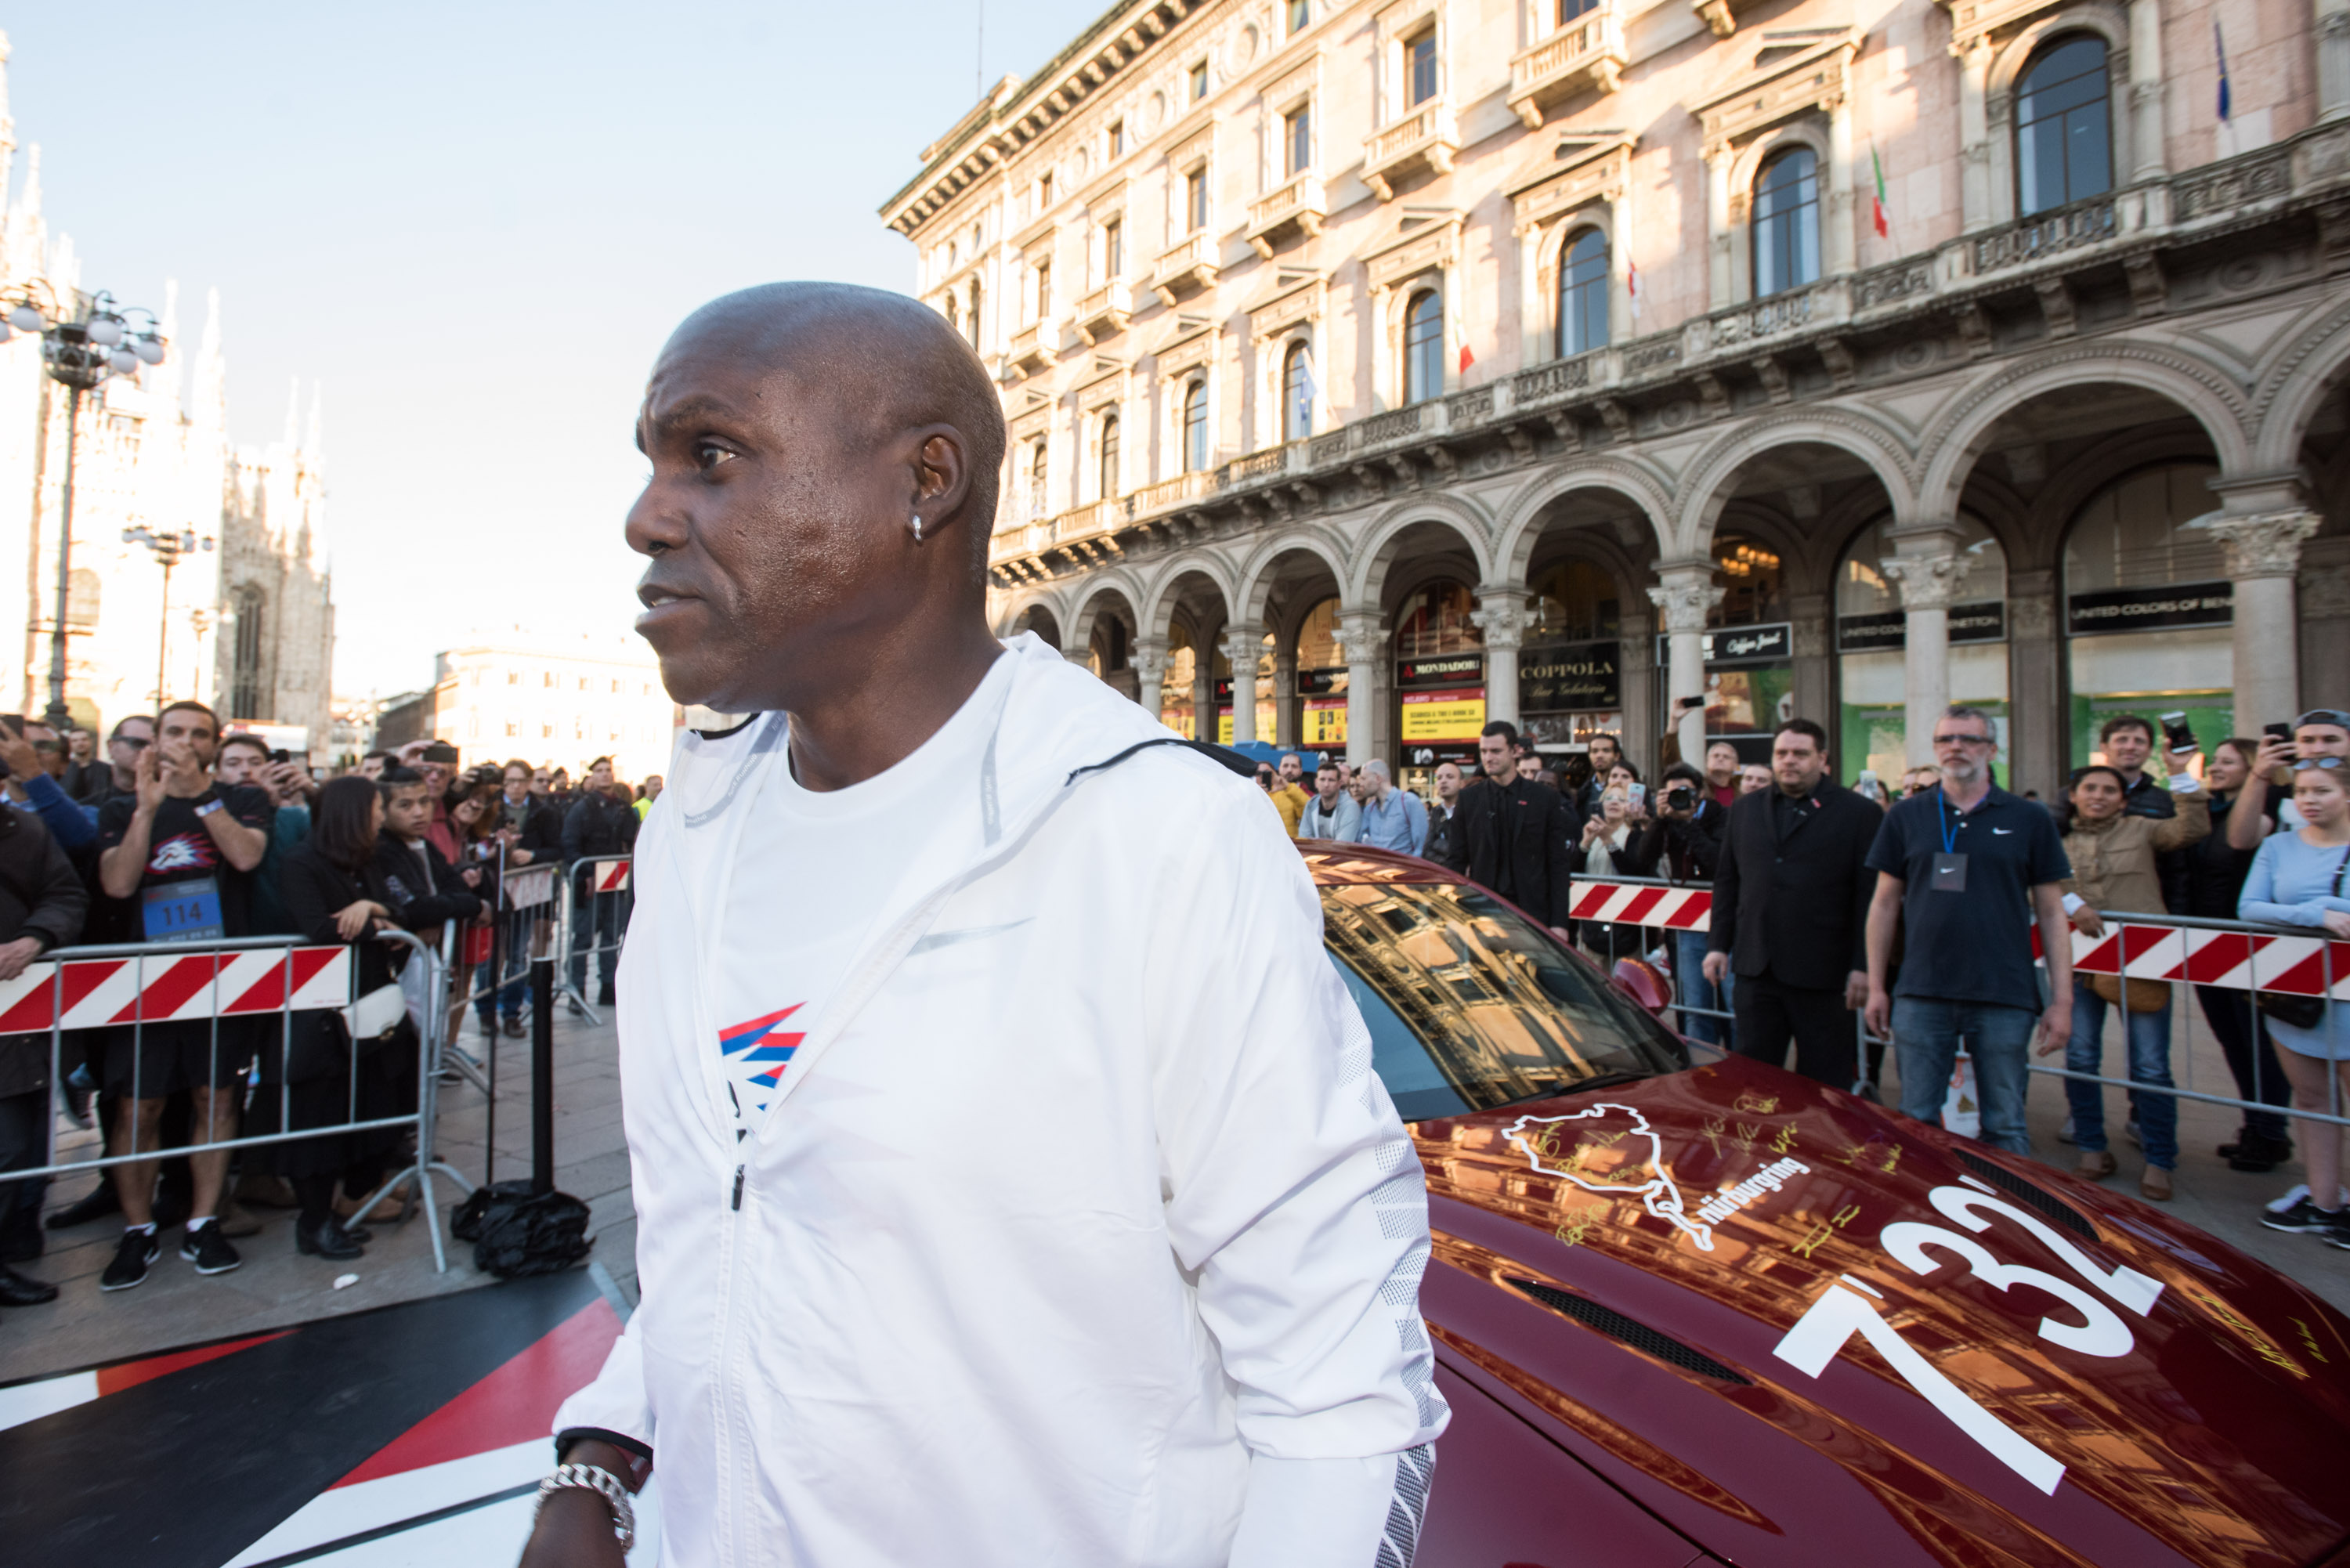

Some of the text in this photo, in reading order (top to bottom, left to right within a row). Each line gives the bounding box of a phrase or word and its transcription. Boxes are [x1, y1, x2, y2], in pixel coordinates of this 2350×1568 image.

[2071, 605, 2120, 621] UNITED
[2120, 602, 2178, 616] COLORS
[2178, 598, 2200, 611] OF
[1842, 624, 1878, 638] UNITED
[1726, 636, 1756, 655] Coffee
[1415, 659, 1480, 674] MONDADORI
[1520, 662, 1614, 680] COPPOLA
[162, 901, 202, 926] 114
[1696, 1155, 1811, 1225] nürburgring
